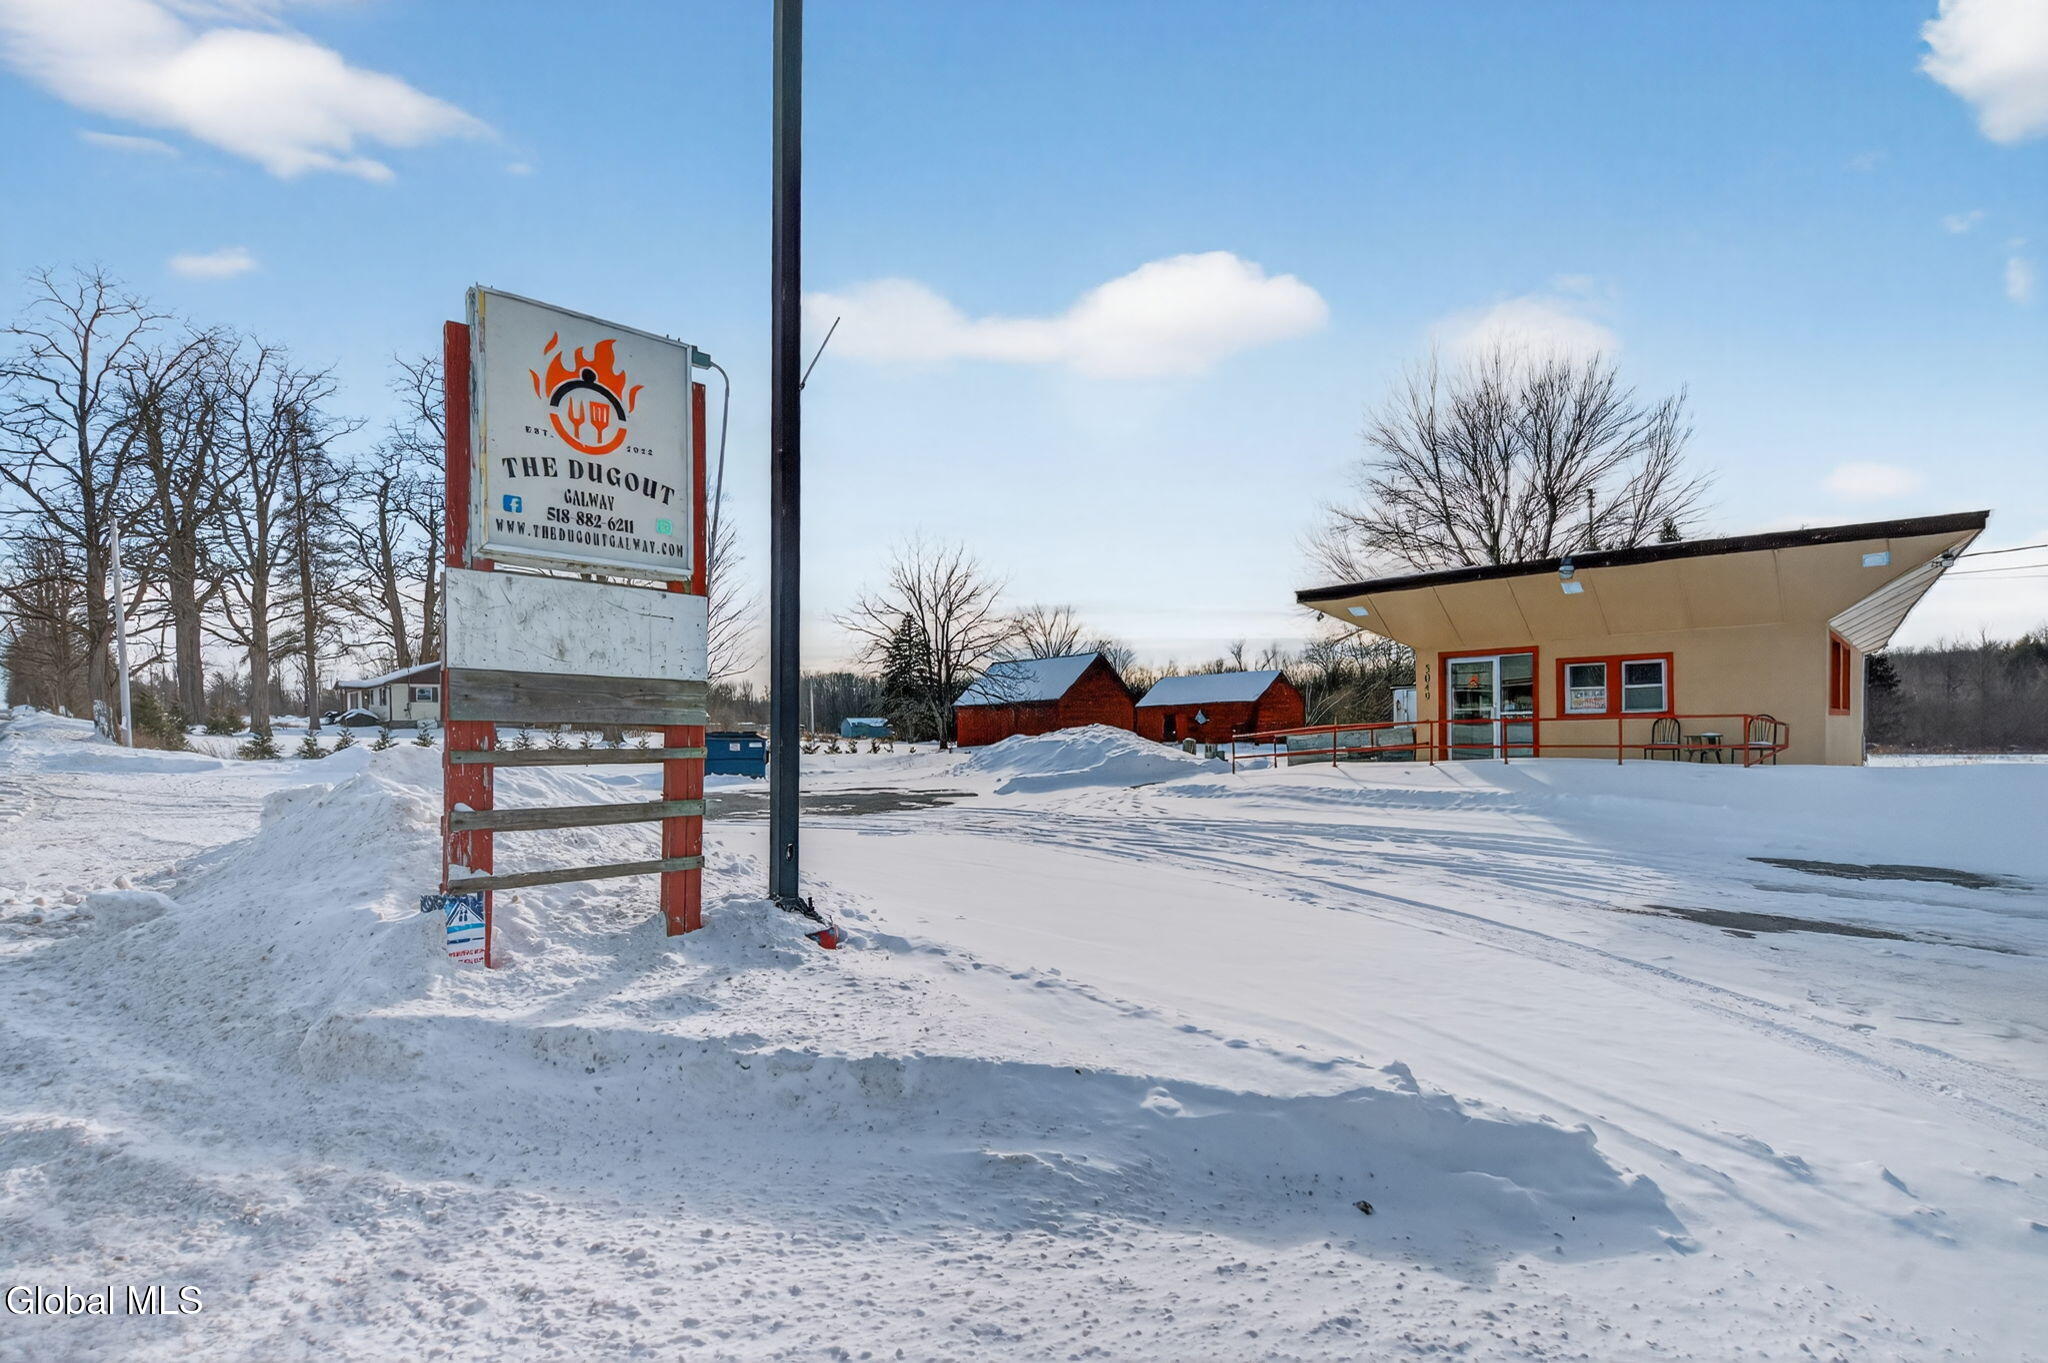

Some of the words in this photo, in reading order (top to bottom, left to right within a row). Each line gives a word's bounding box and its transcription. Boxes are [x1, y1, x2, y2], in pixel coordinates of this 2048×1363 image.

[502, 457, 558, 478] THE
[569, 459, 675, 505] DUGOUT
[564, 489, 614, 511] GALWAY
[547, 507, 634, 534] 518-882-6211
[496, 518, 683, 558] WWW.THEDUGOUTGALWAY.COM
